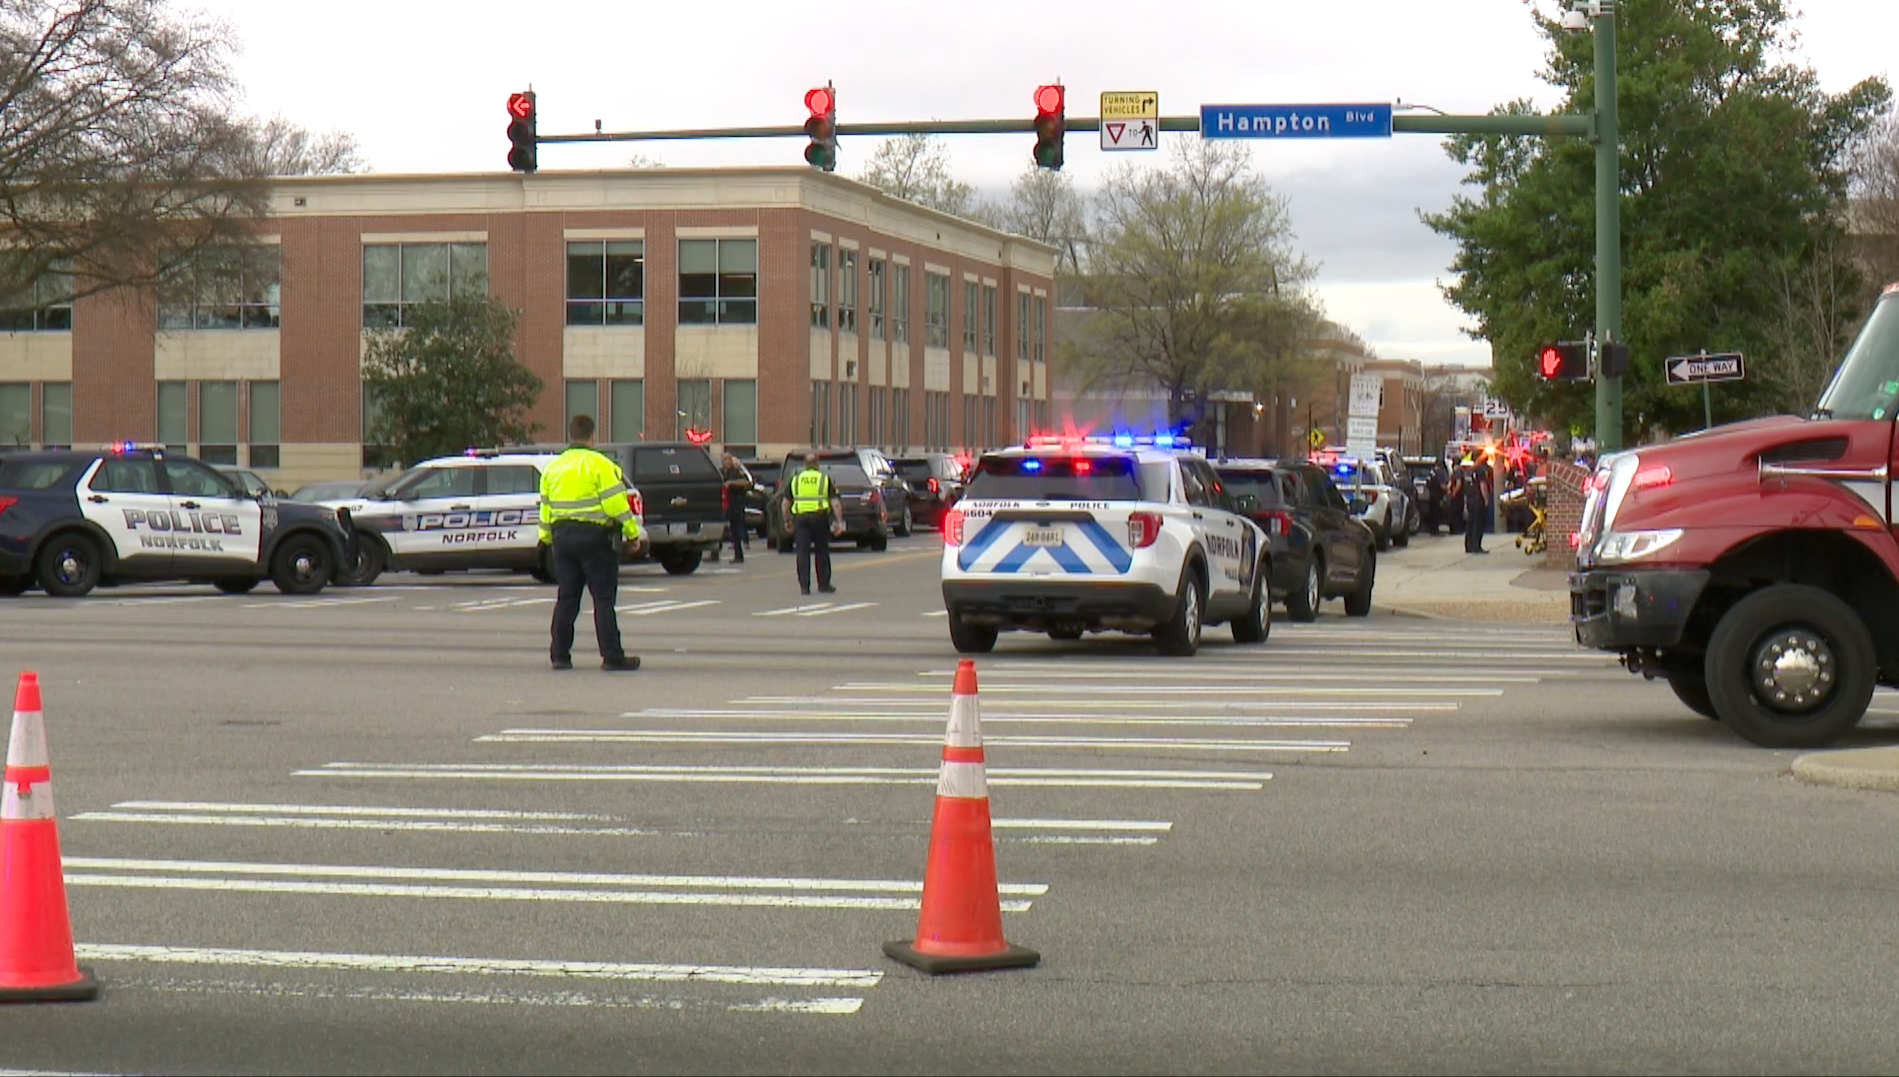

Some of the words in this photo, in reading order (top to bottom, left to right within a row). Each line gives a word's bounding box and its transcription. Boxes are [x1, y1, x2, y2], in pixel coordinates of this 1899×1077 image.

[1104, 95, 1140, 104] TURNING
[1104, 105, 1140, 114] VEHICLES
[1217, 112, 1330, 134] Hampton
[1346, 111, 1374, 122] Blvd
[1128, 128, 1138, 137] TO
[1689, 363, 1710, 374] ONE
[1713, 360, 1734, 371] WAY
[122, 508, 242, 536] POLICE
[419, 510, 539, 530] POLICE
[140, 534, 224, 552] NORFOLK
[442, 530, 518, 544] NORFOLK
[1205, 533, 1239, 560] NORFOLK
